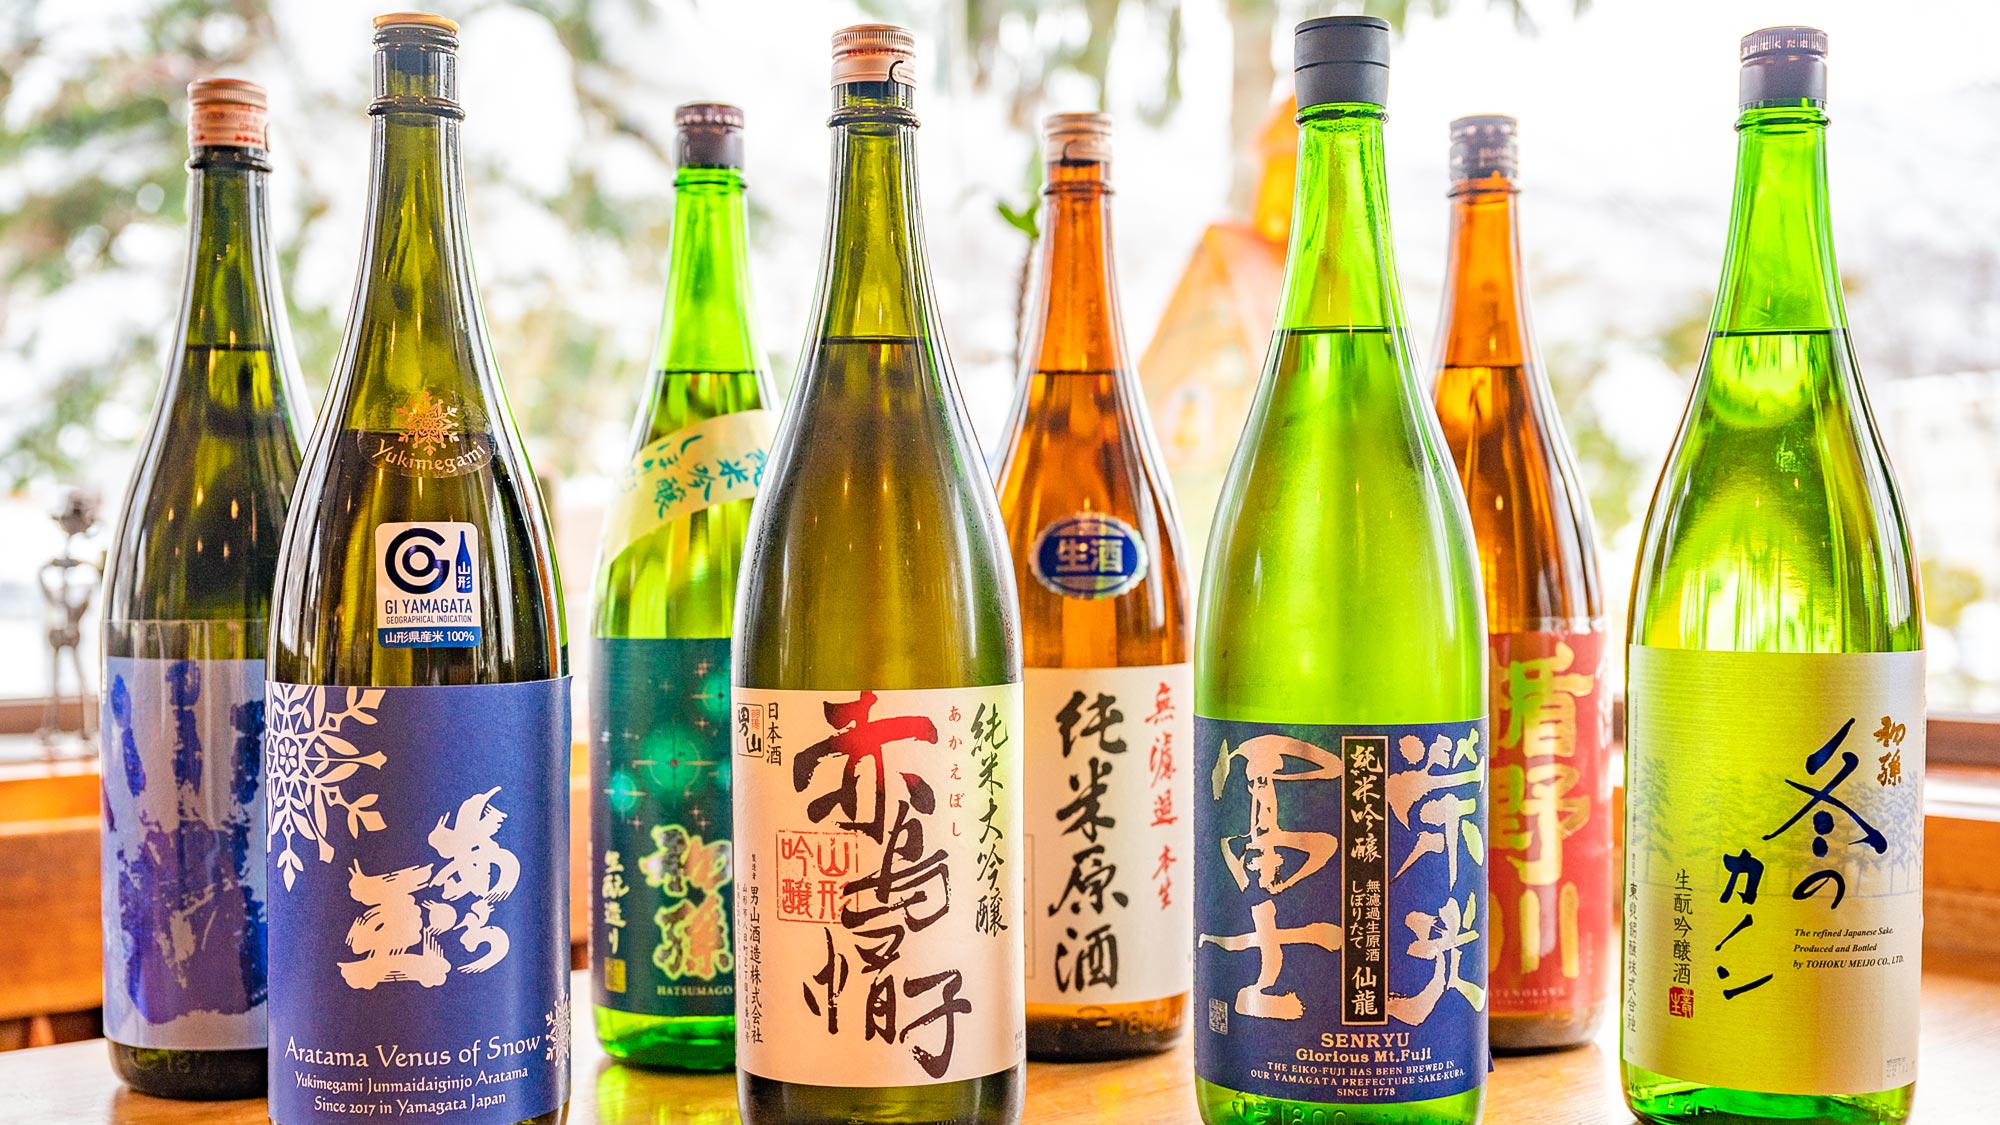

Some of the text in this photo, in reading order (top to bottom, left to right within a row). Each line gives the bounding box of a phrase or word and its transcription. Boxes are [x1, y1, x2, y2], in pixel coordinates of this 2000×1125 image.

[372, 438, 486, 474] Yukimegami
[1056, 539, 1123, 573] 生酒
[457, 562, 472, 589] 山形
[385, 598, 473, 614] GI YAMAGATA
[386, 614, 472, 625] GEOGRAPHICAL INDICATION
[385, 630, 474, 643] 山形県産米 100%
[766, 702, 782, 766] 日本酒
[948, 705, 964, 838] あかえぼし
[970, 703, 1009, 937] 純米大吟醸
[1762, 717, 1888, 909] 冬の
[1049, 690, 1129, 993] 純米原酒
[1350, 880, 1364, 949] しぼりたて
[1365, 879, 1382, 962] 無濾過生原酒
[1715, 848, 1774, 1001] カノン
[1794, 928, 1811, 937] The
[1812, 929, 1841, 939] refined
[1843, 928, 1877, 938] Japanese
[1793, 943, 1878, 952] Produced and Bottled
[750, 886, 764, 1044] 男山酒造株式会社
[1793, 960, 1804, 969] by
[1806, 960, 1847, 968] TOHOKU
[1848, 959, 1876, 968] MEIJO
[656, 985, 734, 996] HATSUMAGO
[1351, 966, 1379, 1017] 仙龍
[284, 1035, 541, 1068] Aratama Venus of Snow
[1321, 1032, 1411, 1048] SENRYU
[1267, 1060, 1455, 1076] THE EIKO-FUJI HAS BEEN BREWED IN
[1296, 1047, 1432, 1063] Glorious Mt.Fuji
[294, 1067, 529, 1094] Yukimegami Junmaidaiginjo Aratama
[1251, 1069, 1270, 1080] OUR
[1274, 1072, 1337, 1086] YAMAGATA
[1342, 1076, 1415, 1086] PREFECTURE
[314, 1093, 506, 1117] Since 2017 in Yamagata Japan
[1337, 1087, 1396, 1097] SINCE 1778
